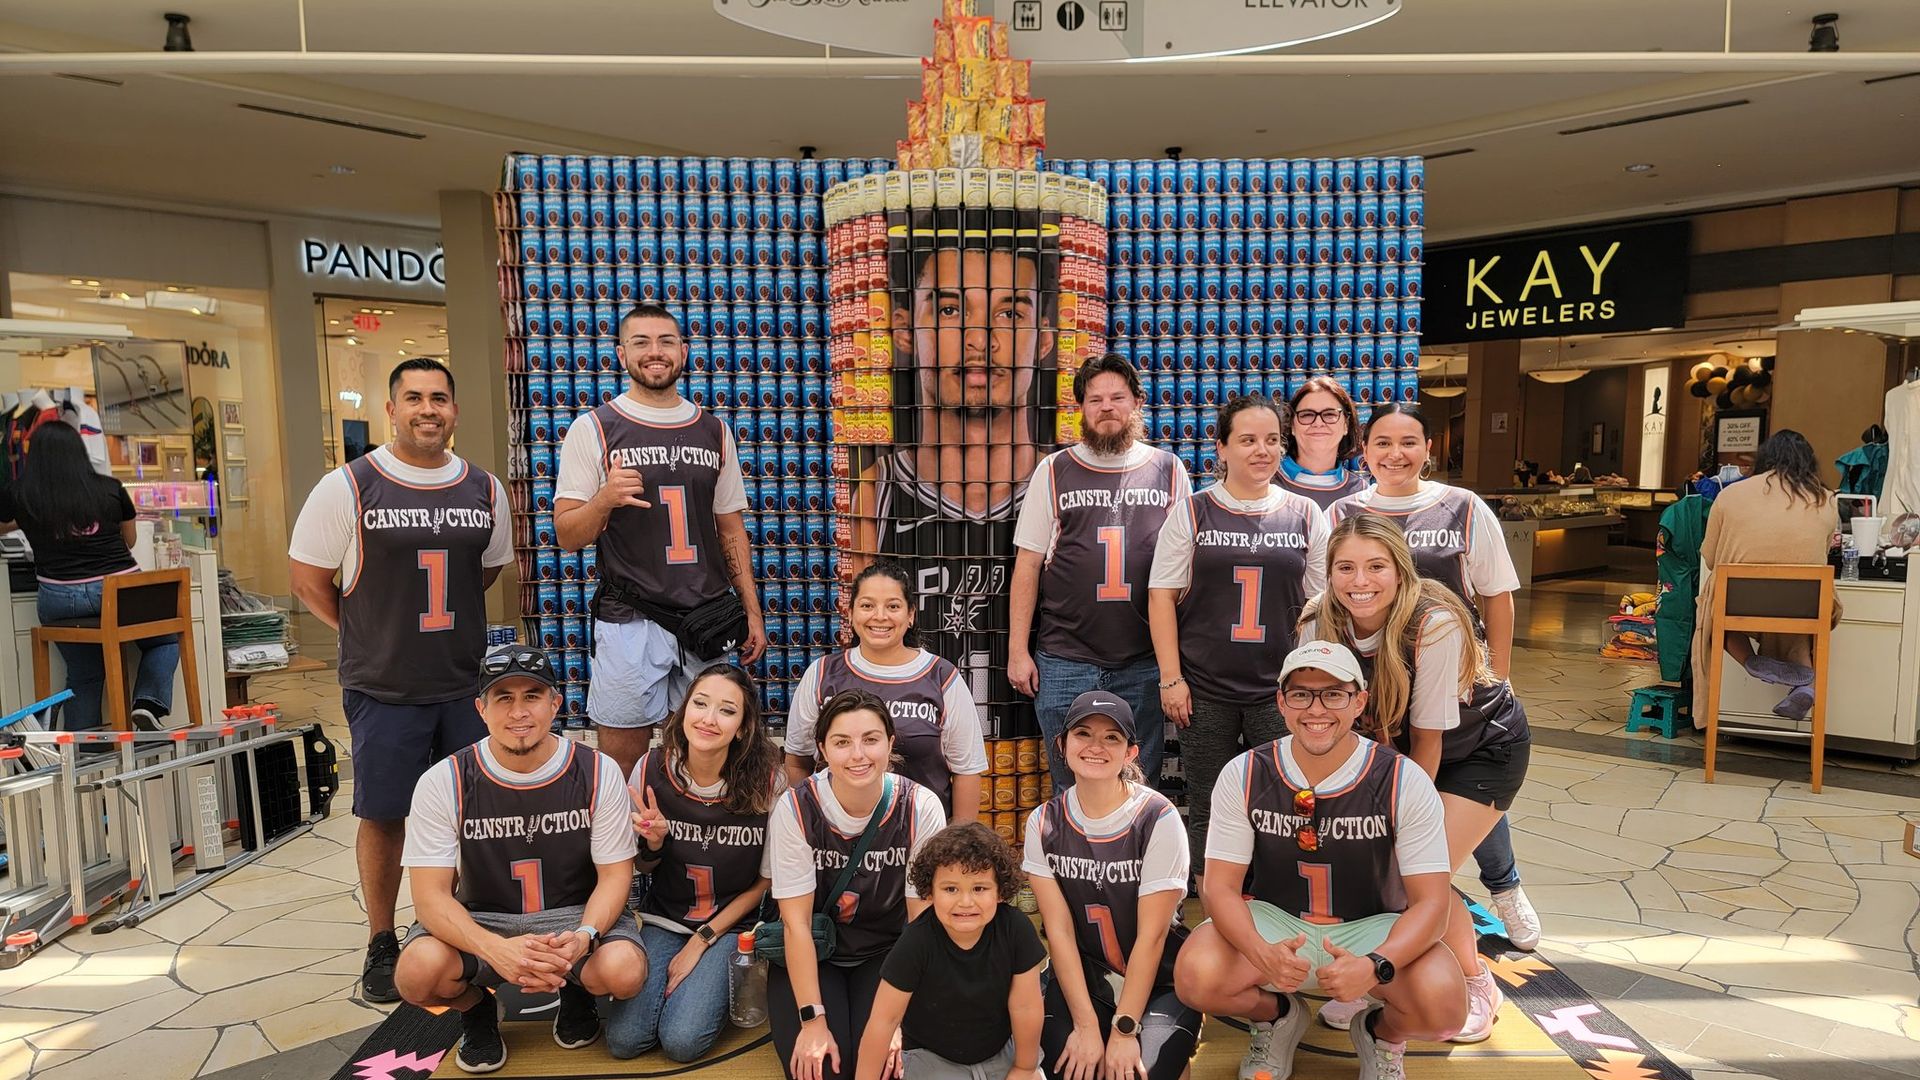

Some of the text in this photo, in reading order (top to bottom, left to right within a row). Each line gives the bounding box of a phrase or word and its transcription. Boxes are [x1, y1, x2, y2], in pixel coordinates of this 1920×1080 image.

[1466, 241, 1621, 307] KAY
[1466, 300, 1616, 330] JEWELERS
[1644, 421, 1664, 431] KAY
[364, 507, 492, 535] CANSTRUCTION
[658, 485, 698, 564] 1
[1059, 488, 1169, 514] CANSTRUCTION
[1096, 526, 1132, 602] 1
[1196, 529, 1306, 554] CANSTRUCTION
[417, 549, 455, 632] 1
[1231, 565, 1266, 643] 1
[463, 808, 591, 845] CANSTRUCTION
[510, 858, 545, 914] 1
[683, 863, 719, 922] 1
[1297, 860, 1345, 924] 1
